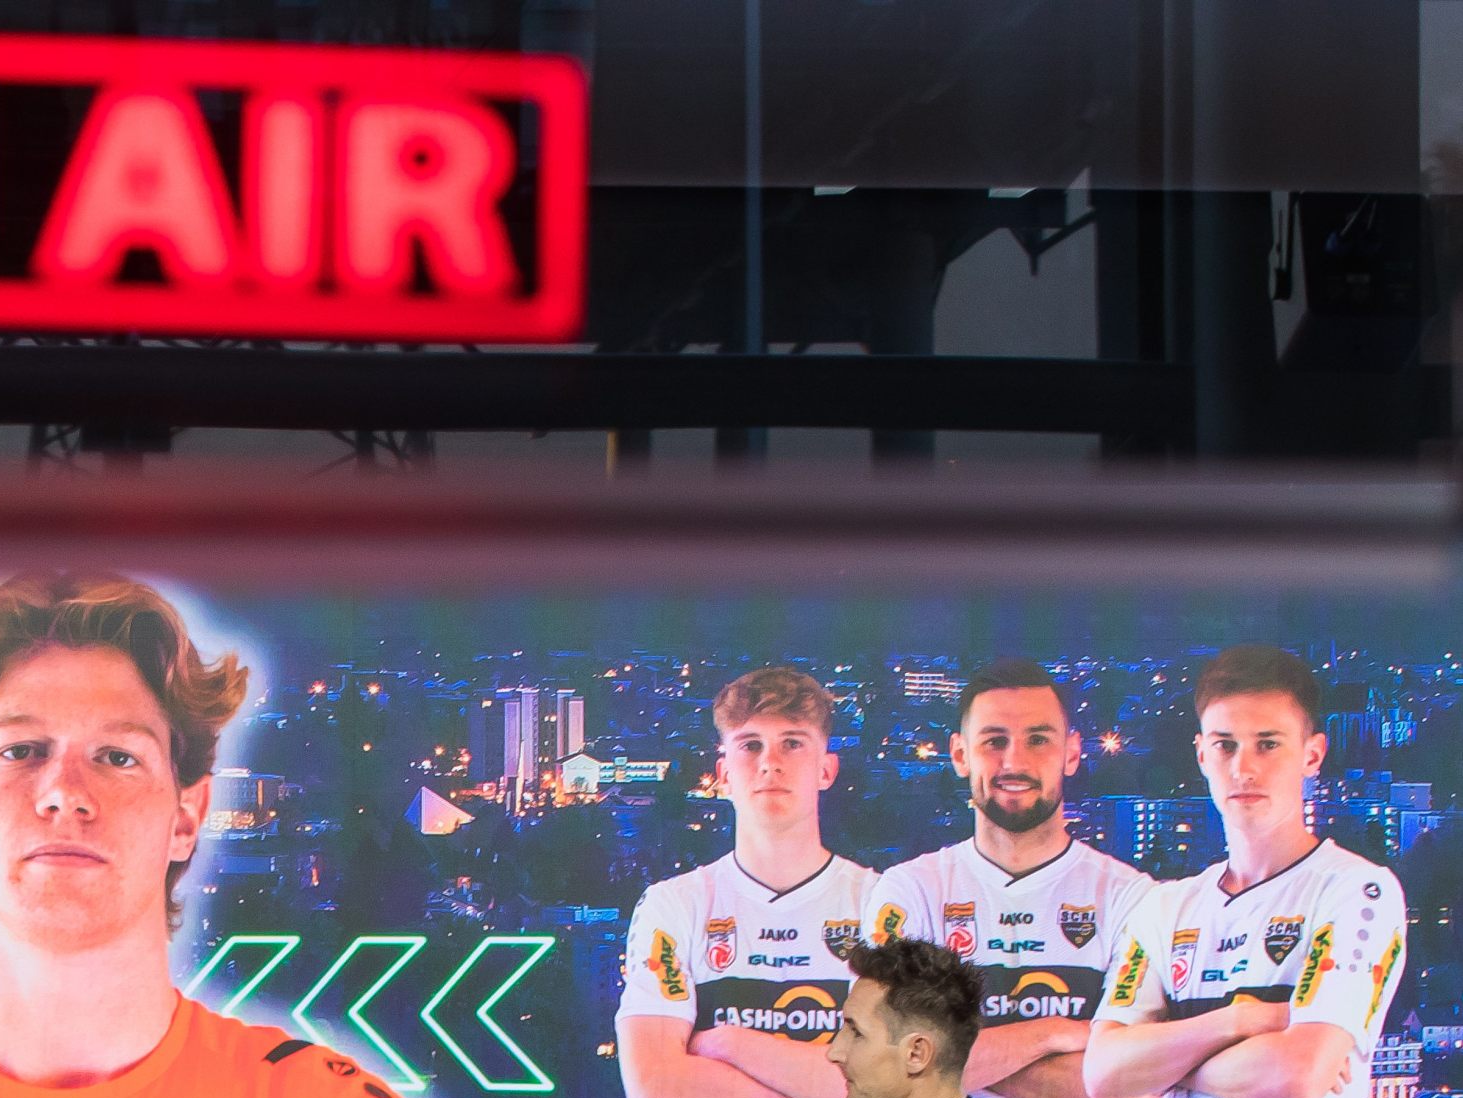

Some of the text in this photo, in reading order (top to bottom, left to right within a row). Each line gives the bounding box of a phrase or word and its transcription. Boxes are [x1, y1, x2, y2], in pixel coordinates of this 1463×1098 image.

[36, 80, 520, 299] AIR
[758, 928, 798, 941] JAKO
[748, 954, 811, 968] GUNZ
